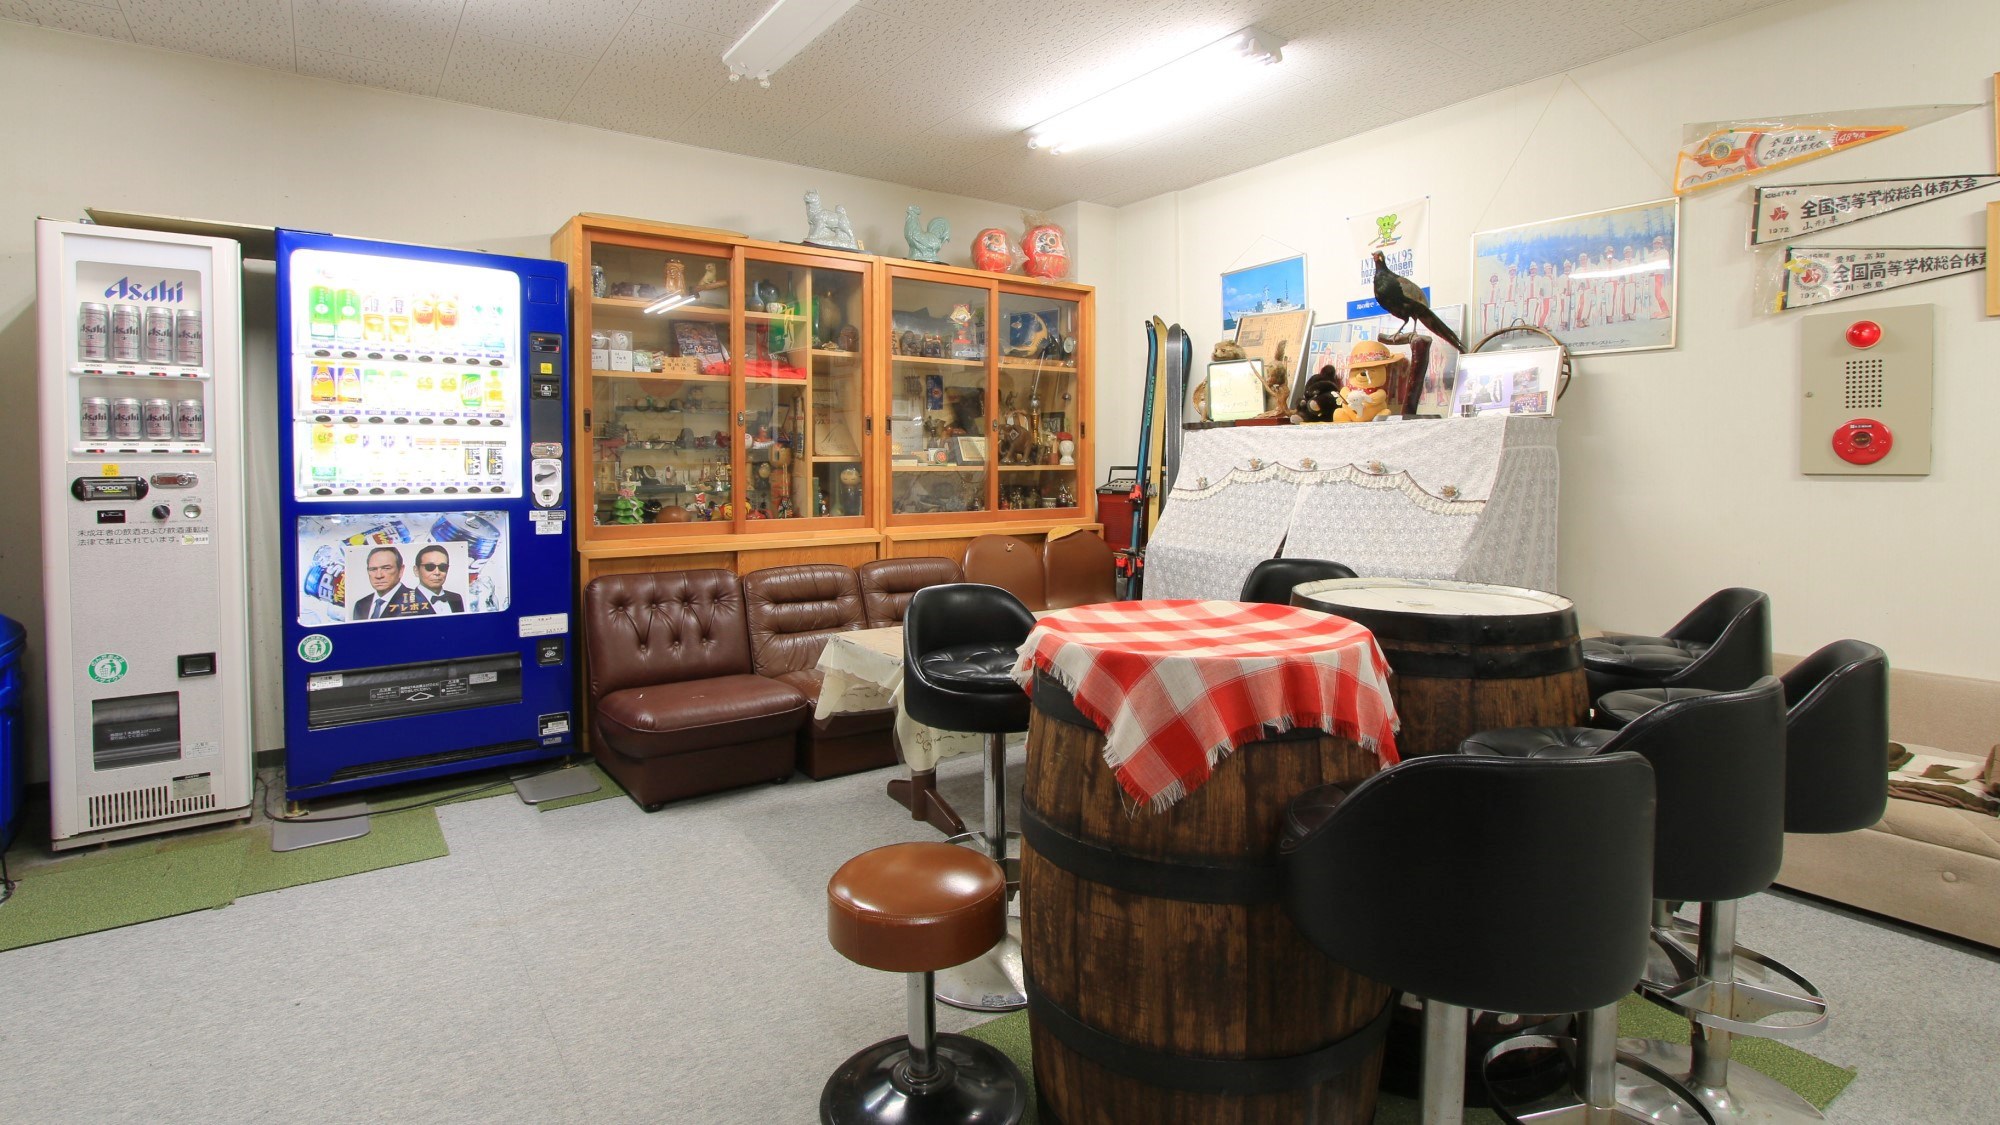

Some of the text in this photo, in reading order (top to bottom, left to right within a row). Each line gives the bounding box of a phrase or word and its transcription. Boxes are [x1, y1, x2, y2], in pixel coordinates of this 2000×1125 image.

[1800, 177, 1977, 220] 全国高等学校総合体育大会
[104, 276, 183, 303] Asahi
[77, 526, 209, 537] 未成年者の飲酒および飲酒運転は
[77, 535, 179, 547] 法律で禁止されています。
